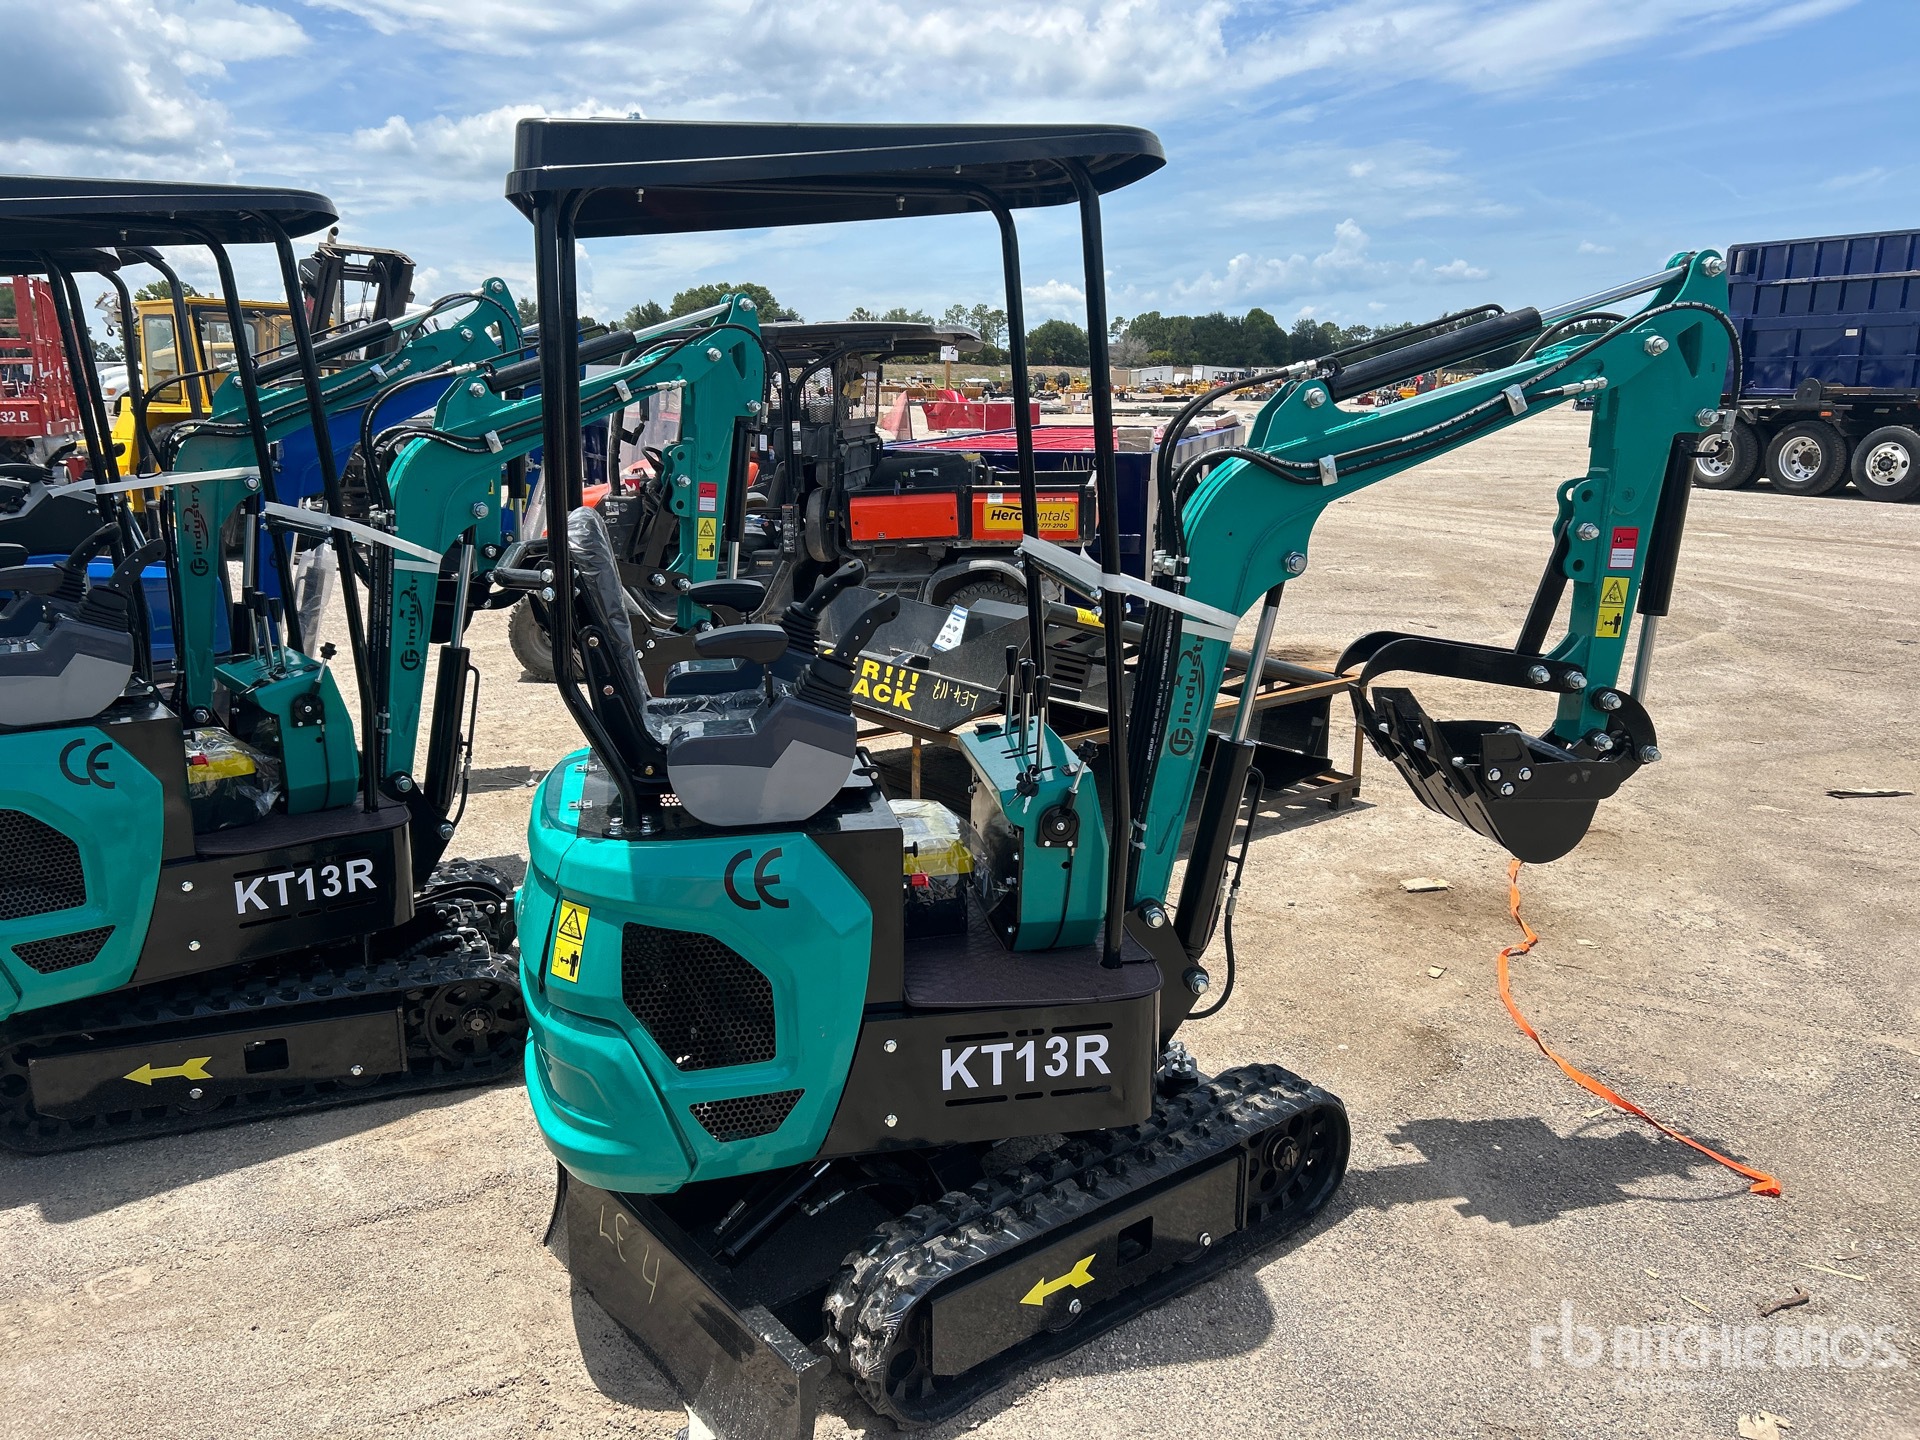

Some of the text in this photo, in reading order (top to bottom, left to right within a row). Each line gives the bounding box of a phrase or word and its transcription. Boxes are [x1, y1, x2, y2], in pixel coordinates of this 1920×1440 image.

[20, 410, 30, 422] R
[234, 858, 378, 915] KT13R
[723, 847, 790, 911] CE
[941, 1034, 1112, 1091] KT13R
